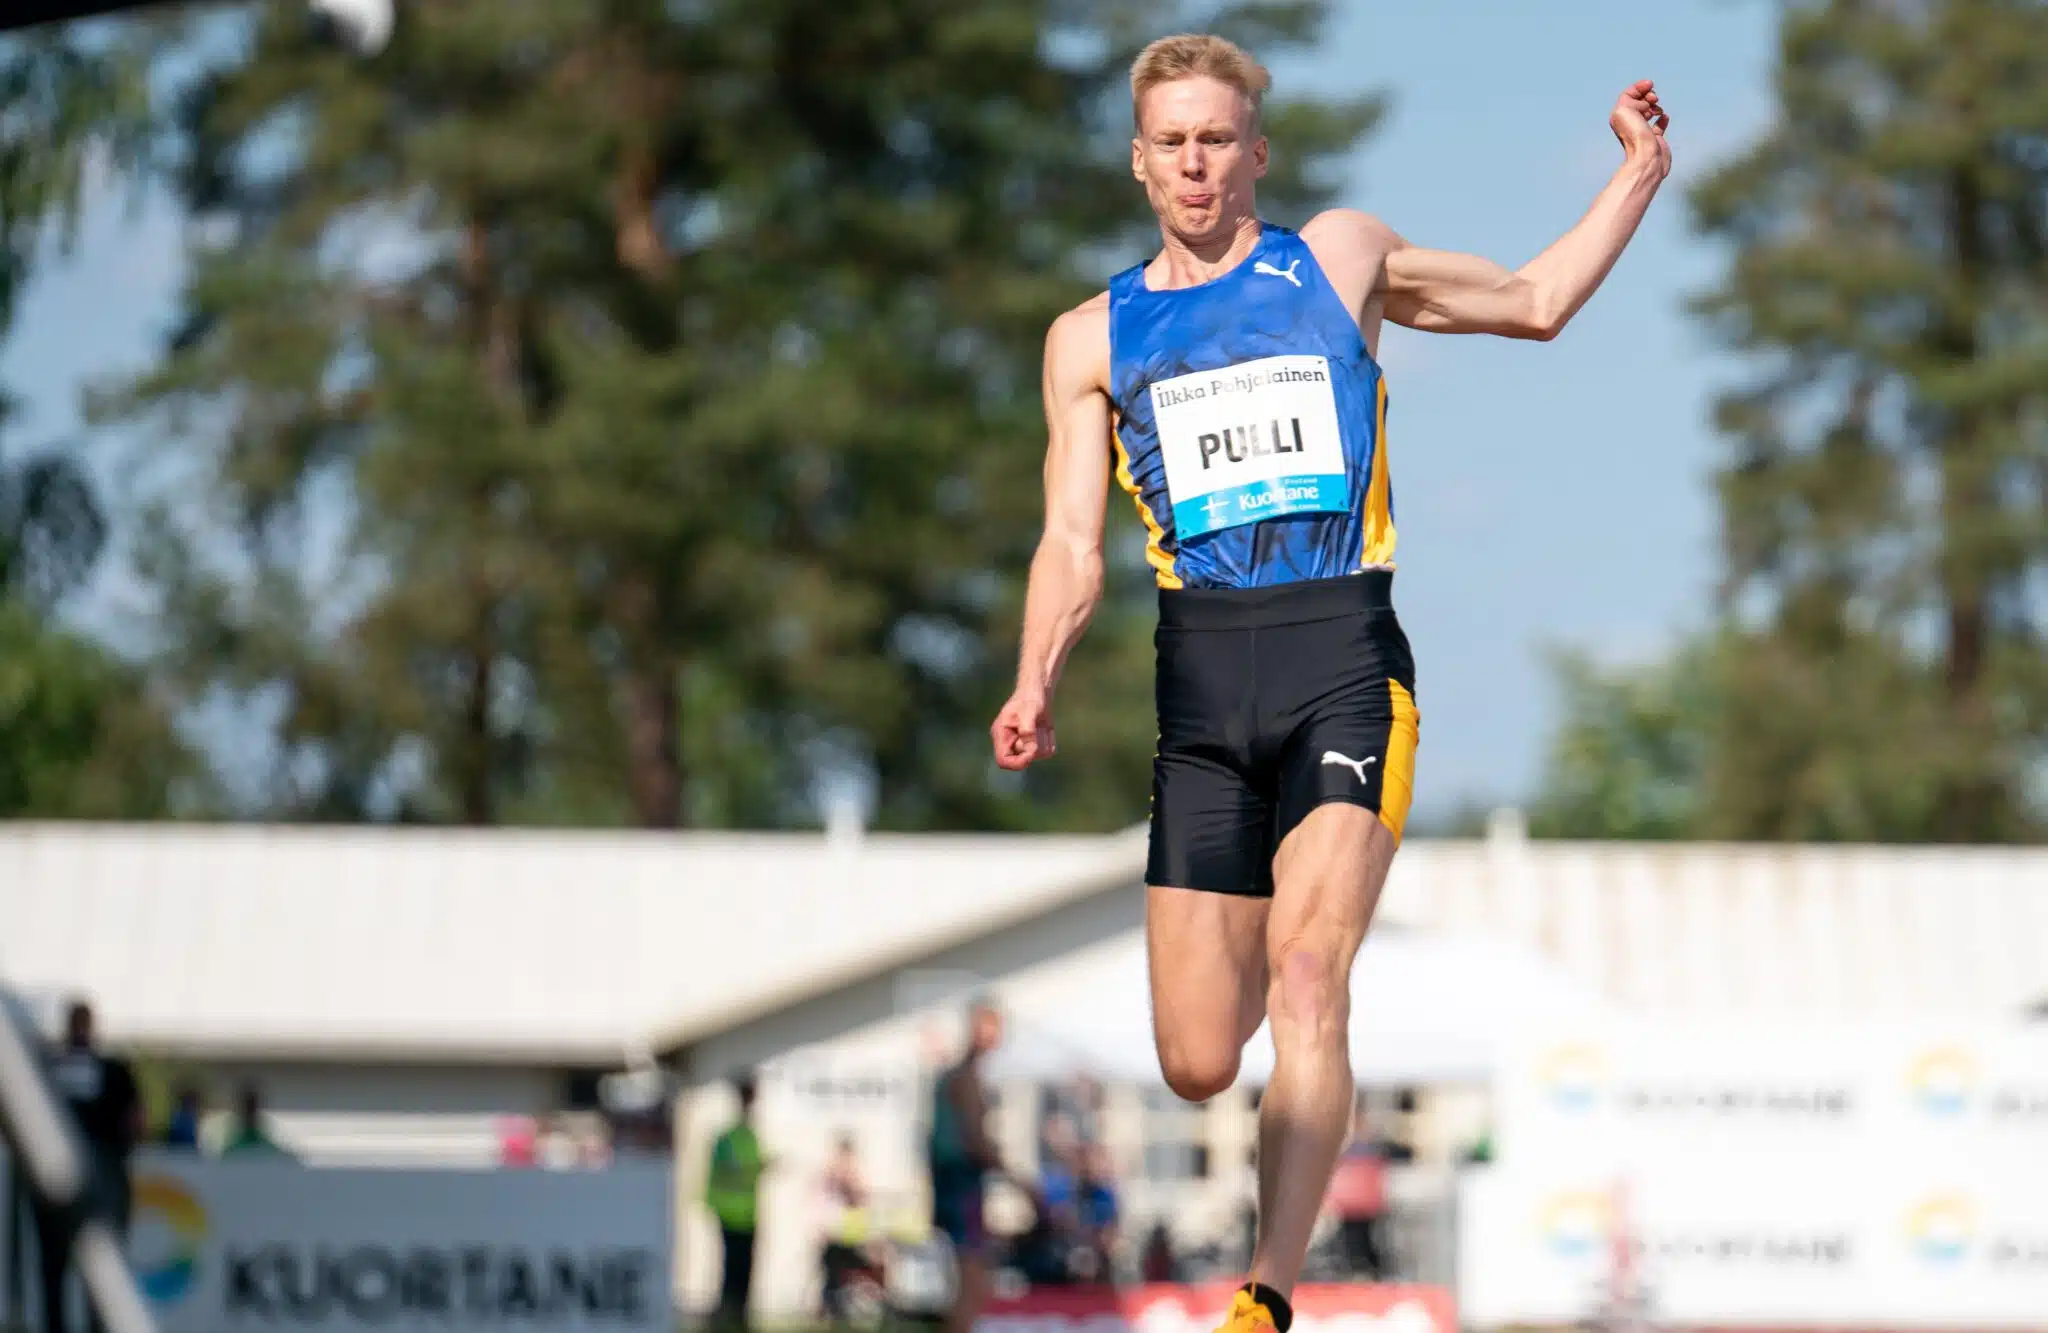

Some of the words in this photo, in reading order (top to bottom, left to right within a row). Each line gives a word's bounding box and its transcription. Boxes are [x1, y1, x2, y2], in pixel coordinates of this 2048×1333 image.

[1157, 386, 1206, 408] Ilkka
[1197, 417, 1304, 470] PULLI
[1239, 486, 1319, 511] Kuotane
[222, 1244, 652, 1320] KUORTANE
